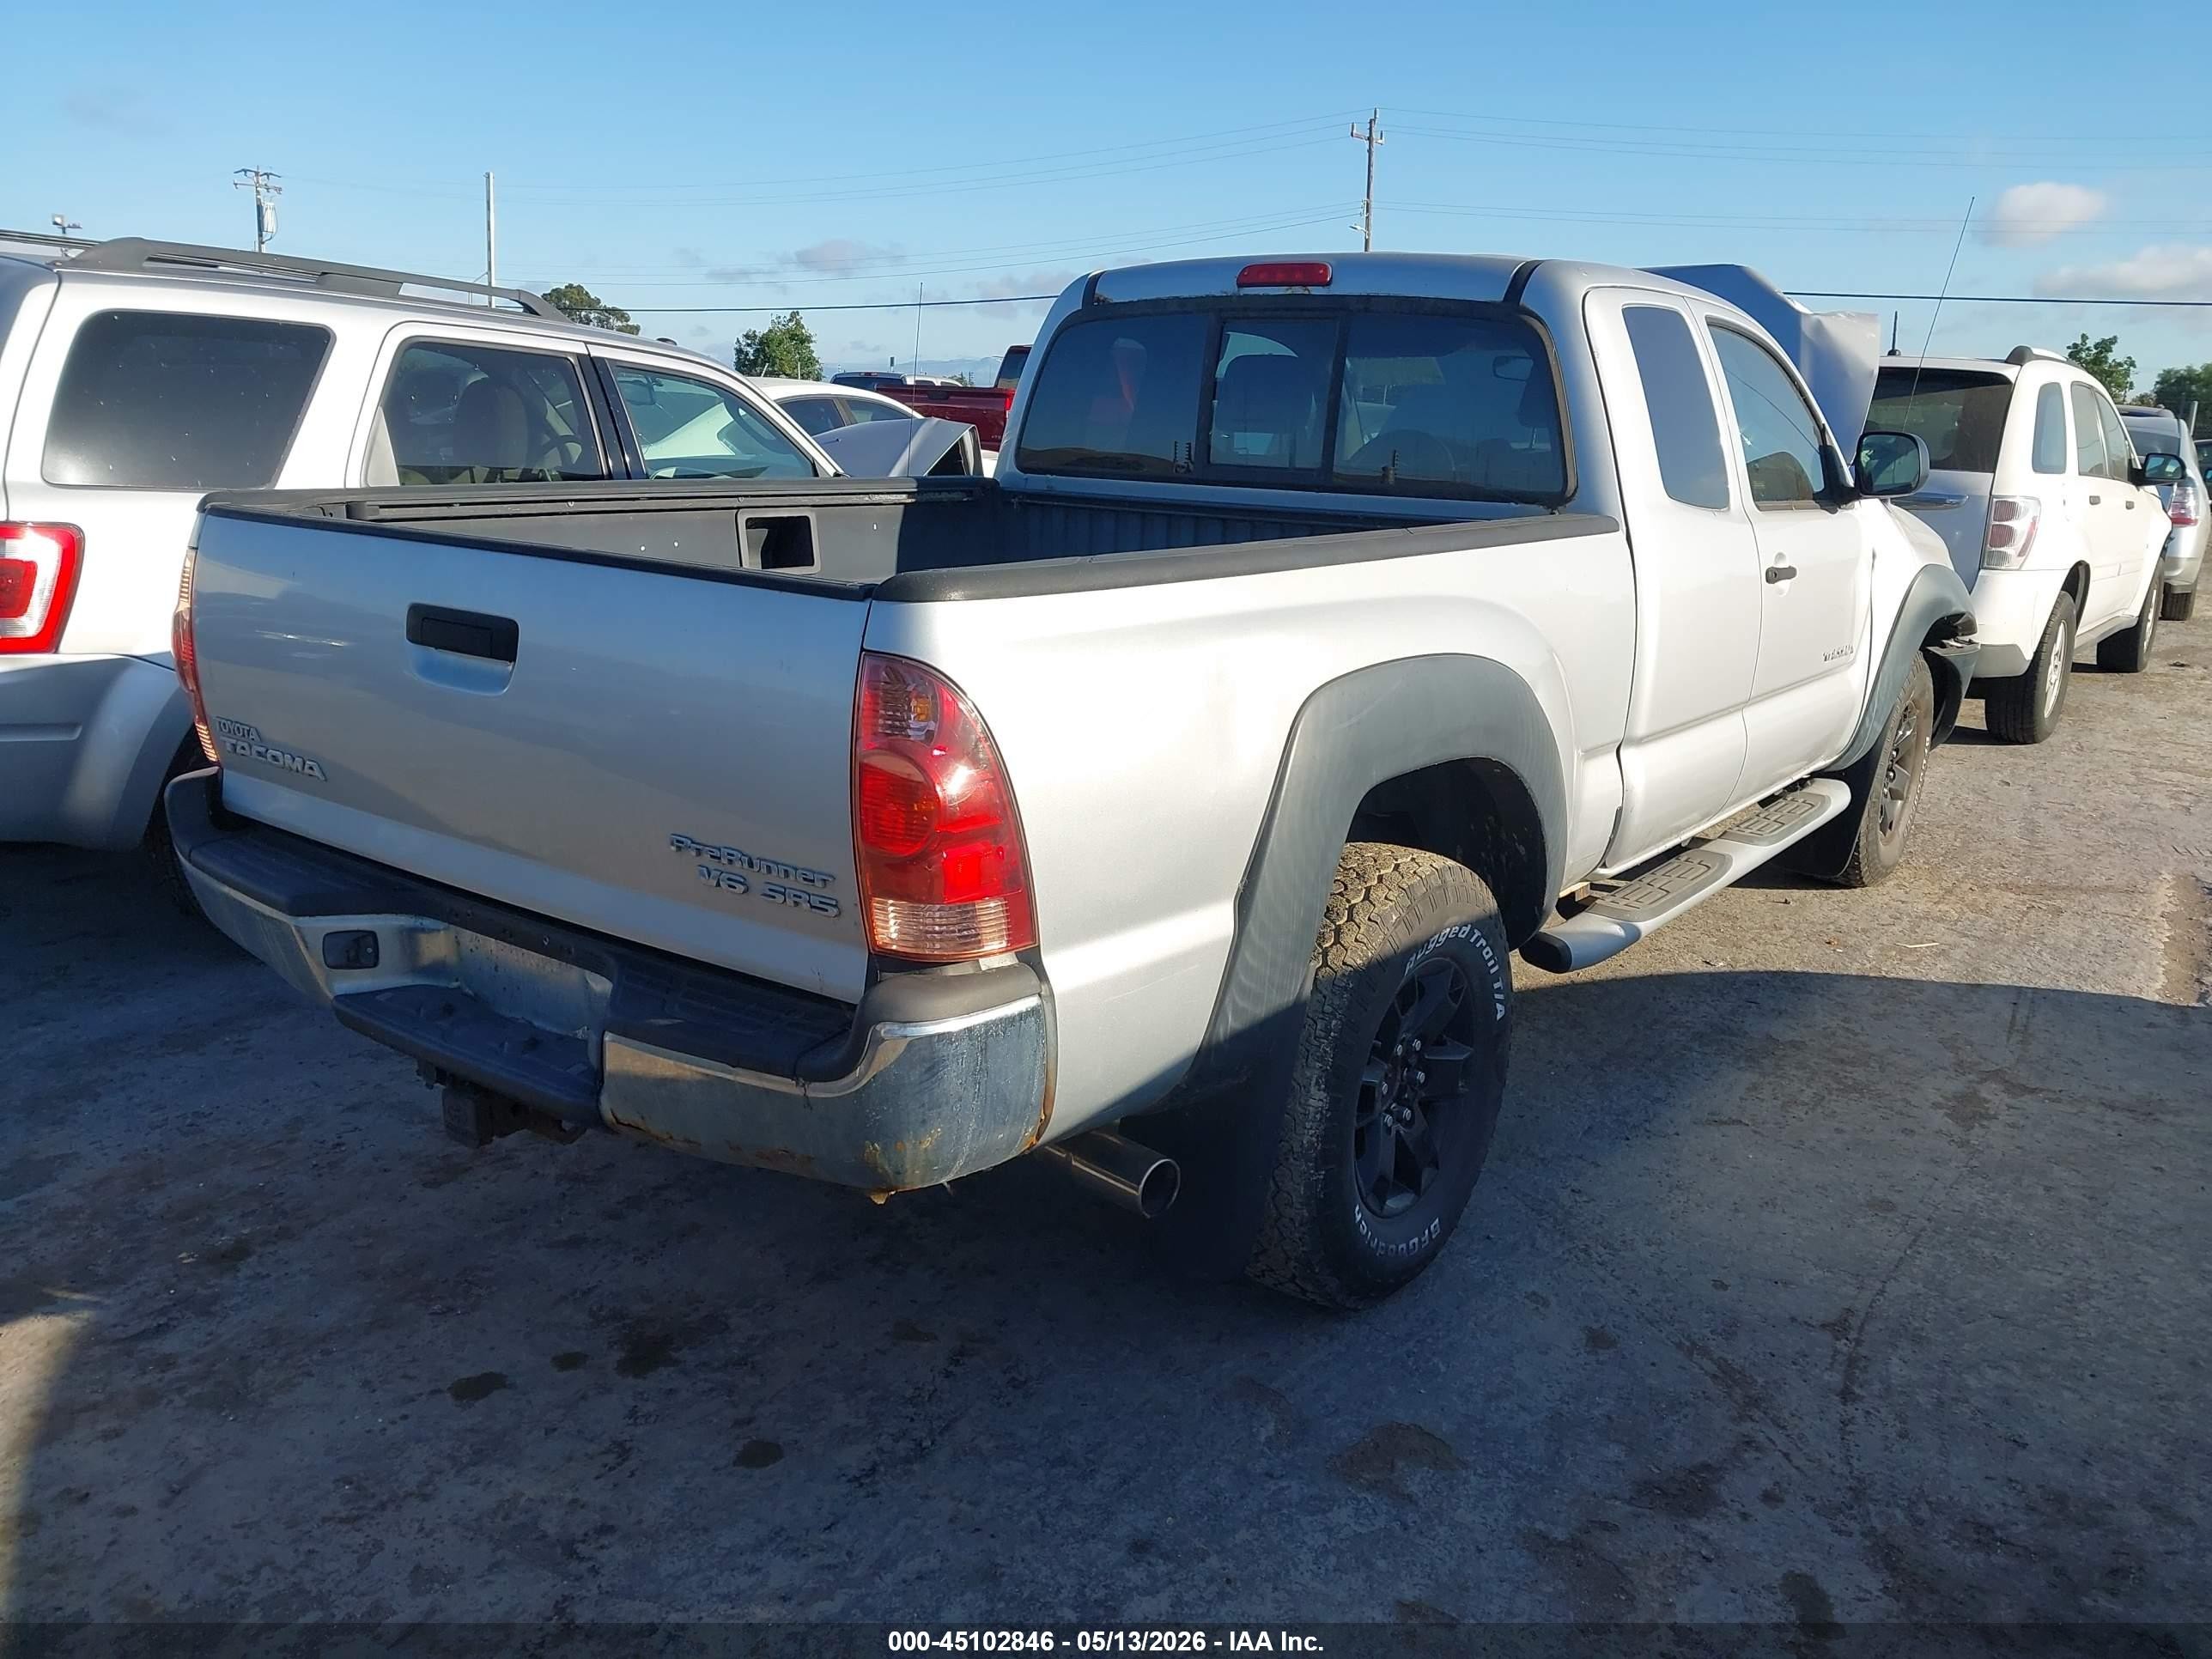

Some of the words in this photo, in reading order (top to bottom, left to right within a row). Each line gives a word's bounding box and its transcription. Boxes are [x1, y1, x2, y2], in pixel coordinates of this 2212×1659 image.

[216, 716, 262, 741] TOYOTA
[220, 735, 328, 782] TACOMA
[670, 833, 836, 888] PreRunner
[697, 865, 749, 894] V6
[760, 881, 842, 918] SR5
[1404, 924, 1472, 976] Rugged
[1469, 928, 1500, 975] Trail
[1493, 976, 1505, 1021] T/A
[1354, 1202, 1442, 1257] BFGoodrich
